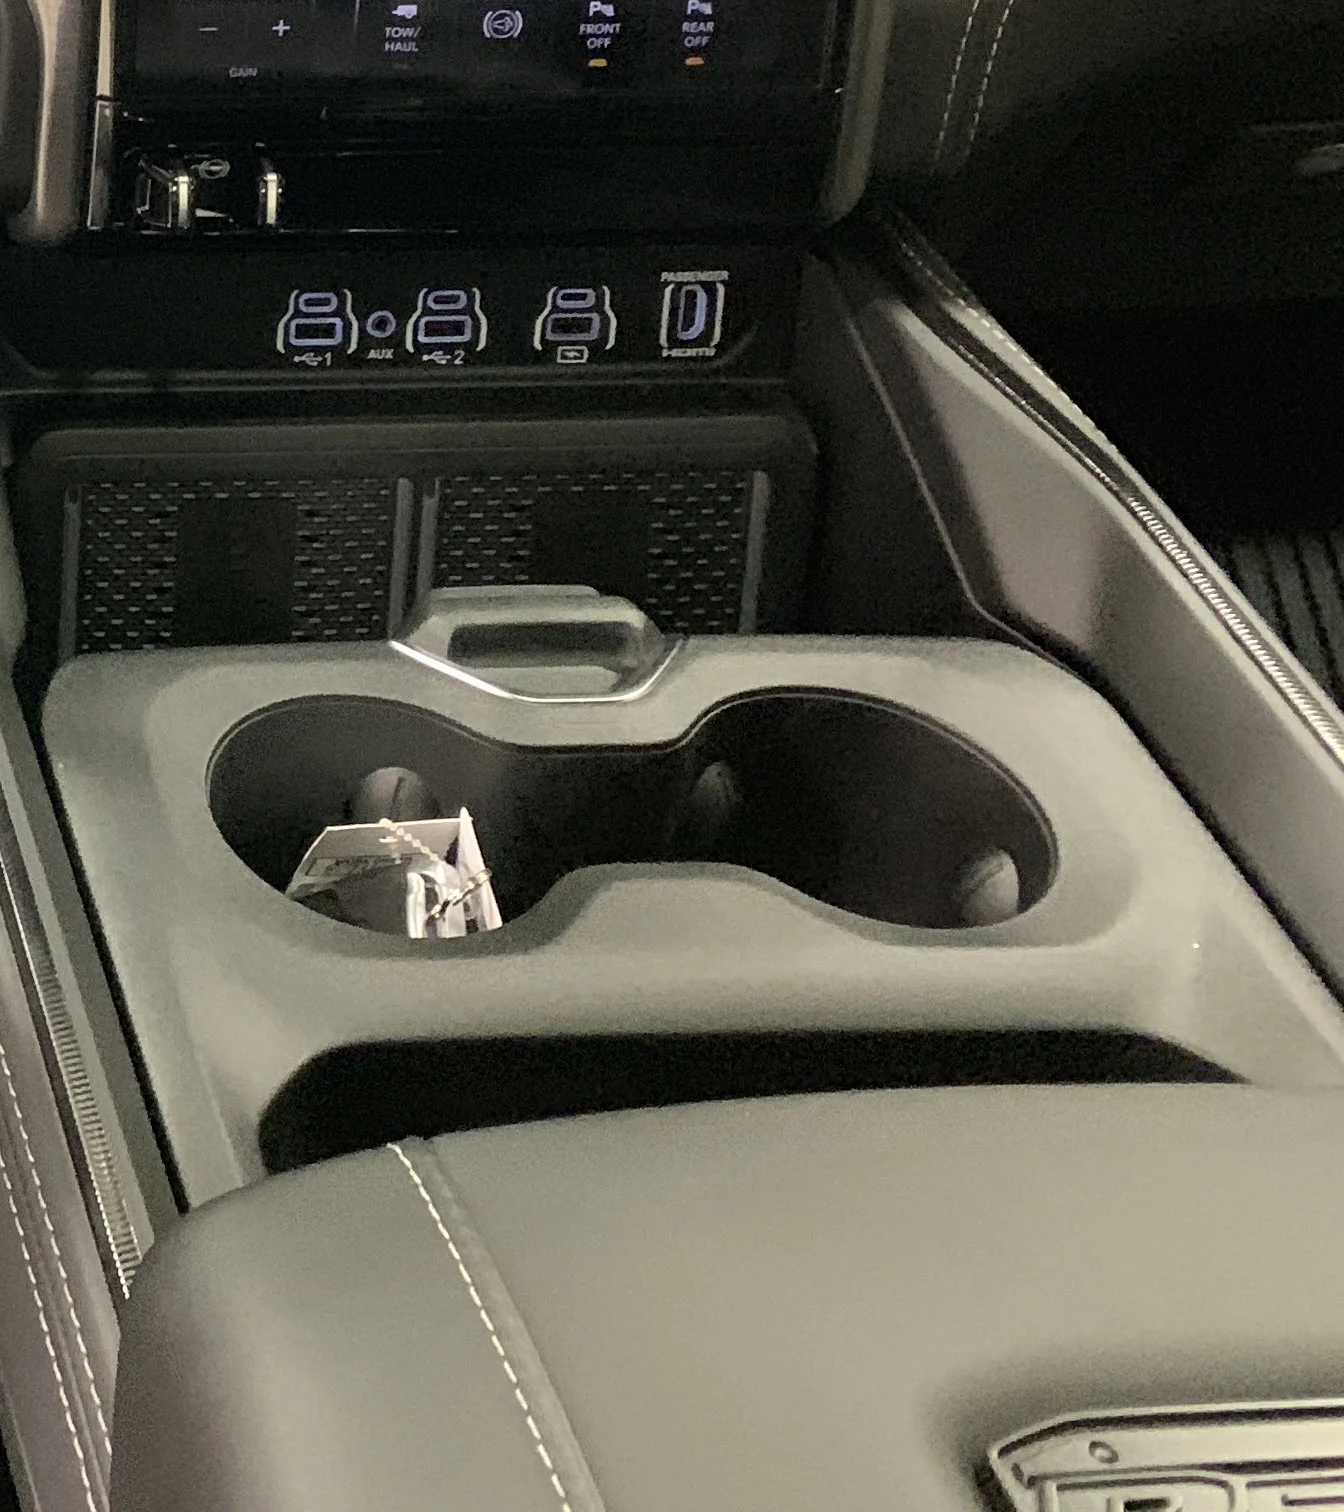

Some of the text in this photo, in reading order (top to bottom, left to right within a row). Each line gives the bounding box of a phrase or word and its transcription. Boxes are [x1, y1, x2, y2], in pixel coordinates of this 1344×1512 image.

[384, 26, 421, 39] TOW/
[579, 23, 621, 35] FRONT
[682, 21, 715, 33] REAR
[384, 41, 419, 52] HAUL
[587, 38, 611, 50] OFF
[684, 36, 710, 48] OFF
[229, 67, 258, 78] GAIN
[323, 352, 332, 366] 1
[367, 348, 394, 360] AUX
[454, 350, 465, 365] 2
